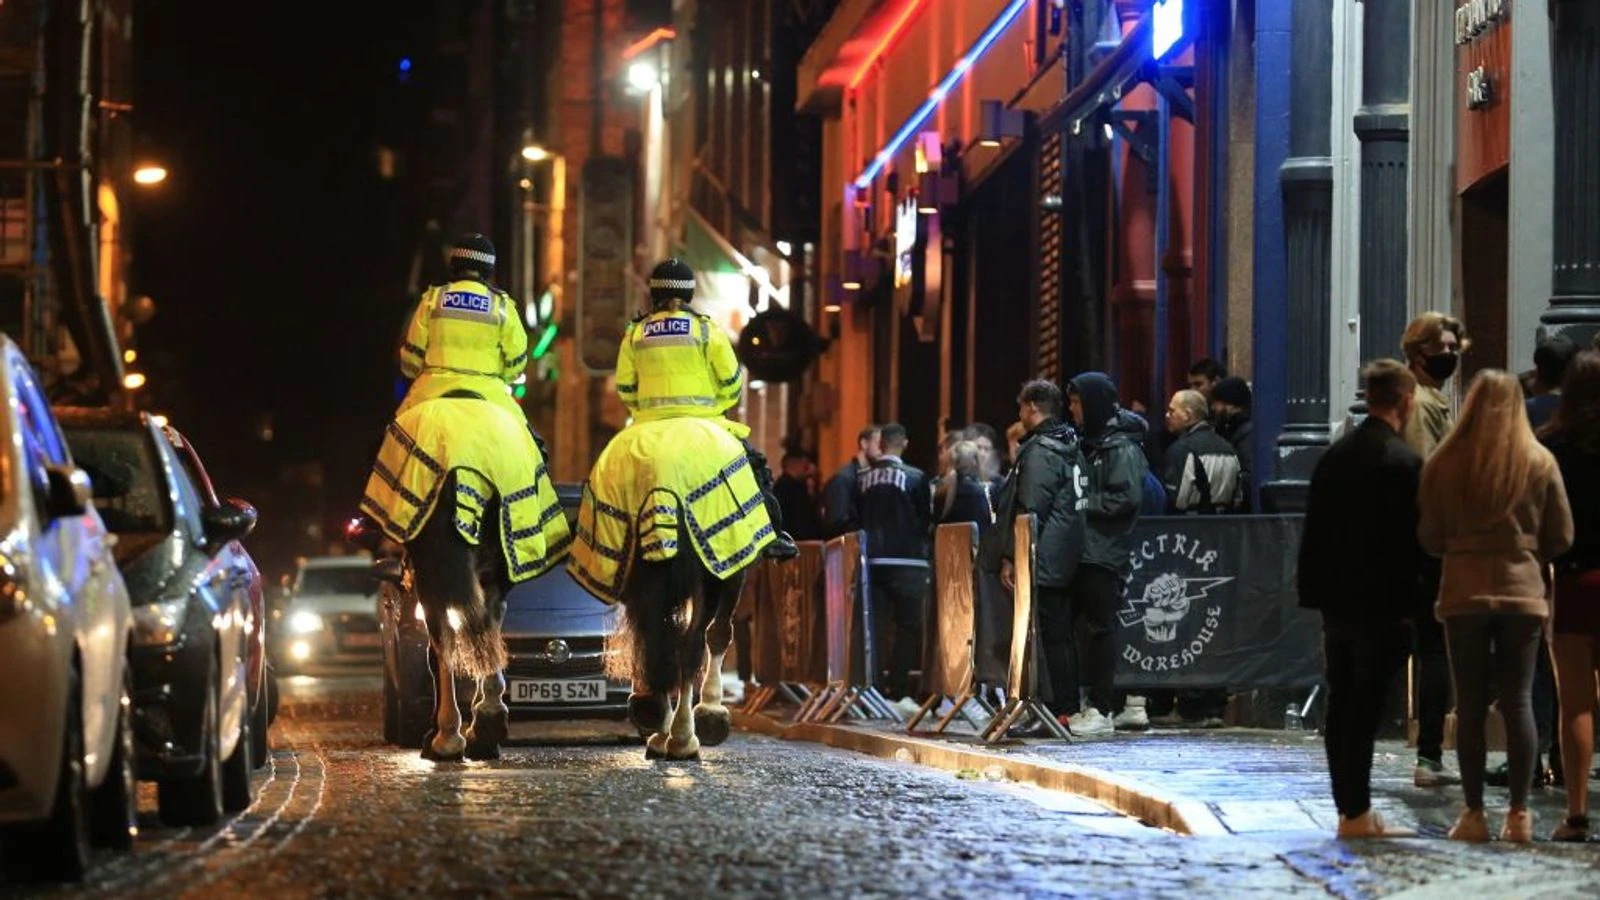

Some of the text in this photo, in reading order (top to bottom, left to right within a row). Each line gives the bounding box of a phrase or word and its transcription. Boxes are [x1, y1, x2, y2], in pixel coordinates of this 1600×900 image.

[444, 292, 489, 312] POLICE
[644, 320, 689, 336] POLICE
[1122, 533, 1218, 597] ECTRIK
[1121, 604, 1222, 672] WAREHOUSE
[518, 682, 599, 699] DP69 SZN
